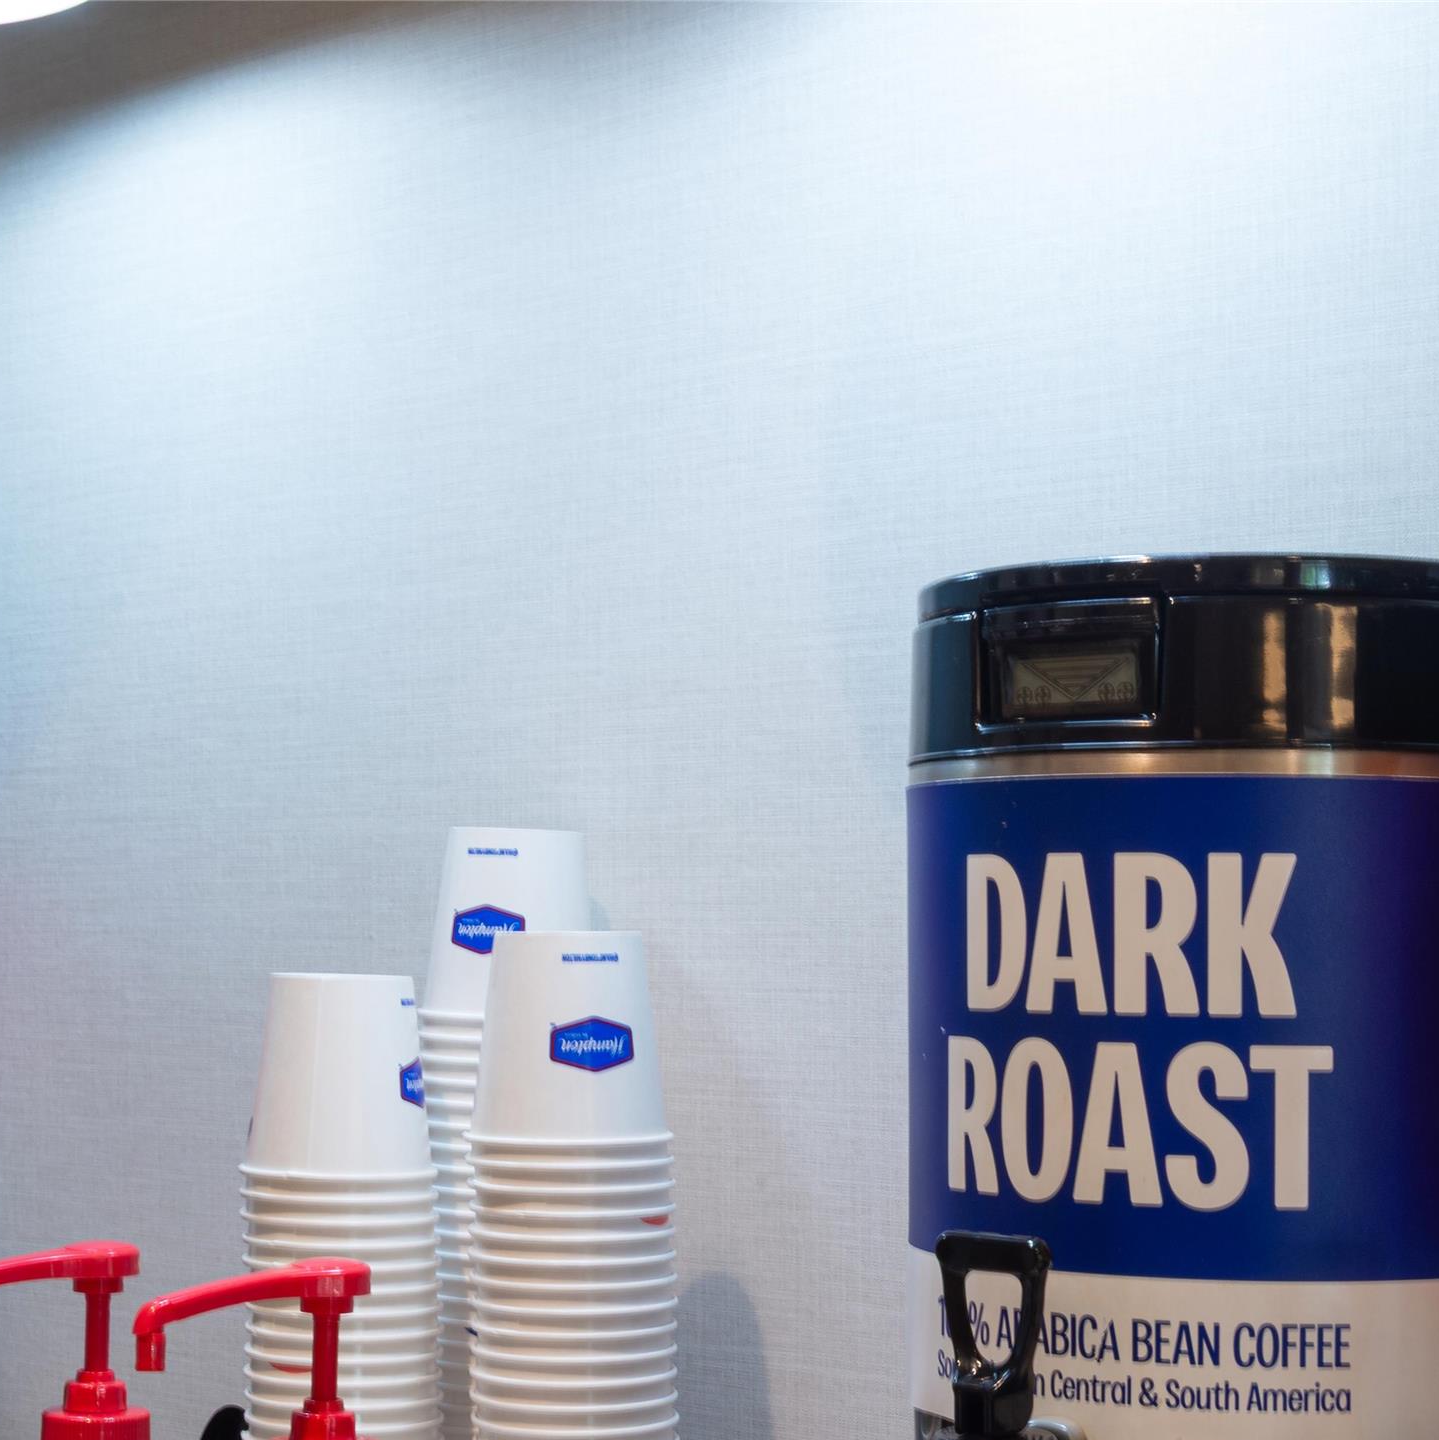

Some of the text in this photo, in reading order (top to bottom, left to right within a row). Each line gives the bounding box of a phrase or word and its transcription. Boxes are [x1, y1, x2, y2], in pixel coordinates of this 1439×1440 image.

[966, 851, 1298, 1018] DARK
[560, 1033, 628, 1056] Hampton
[947, 1035, 1334, 1212] ROAST
[1130, 1317, 1221, 1367] BEAN
[1232, 1321, 1352, 1369] COFFEE
[1050, 1369, 1132, 1406] Central
[1138, 1377, 1159, 1408] &
[1165, 1378, 1240, 1412] South
[1246, 1381, 1352, 1413] America
